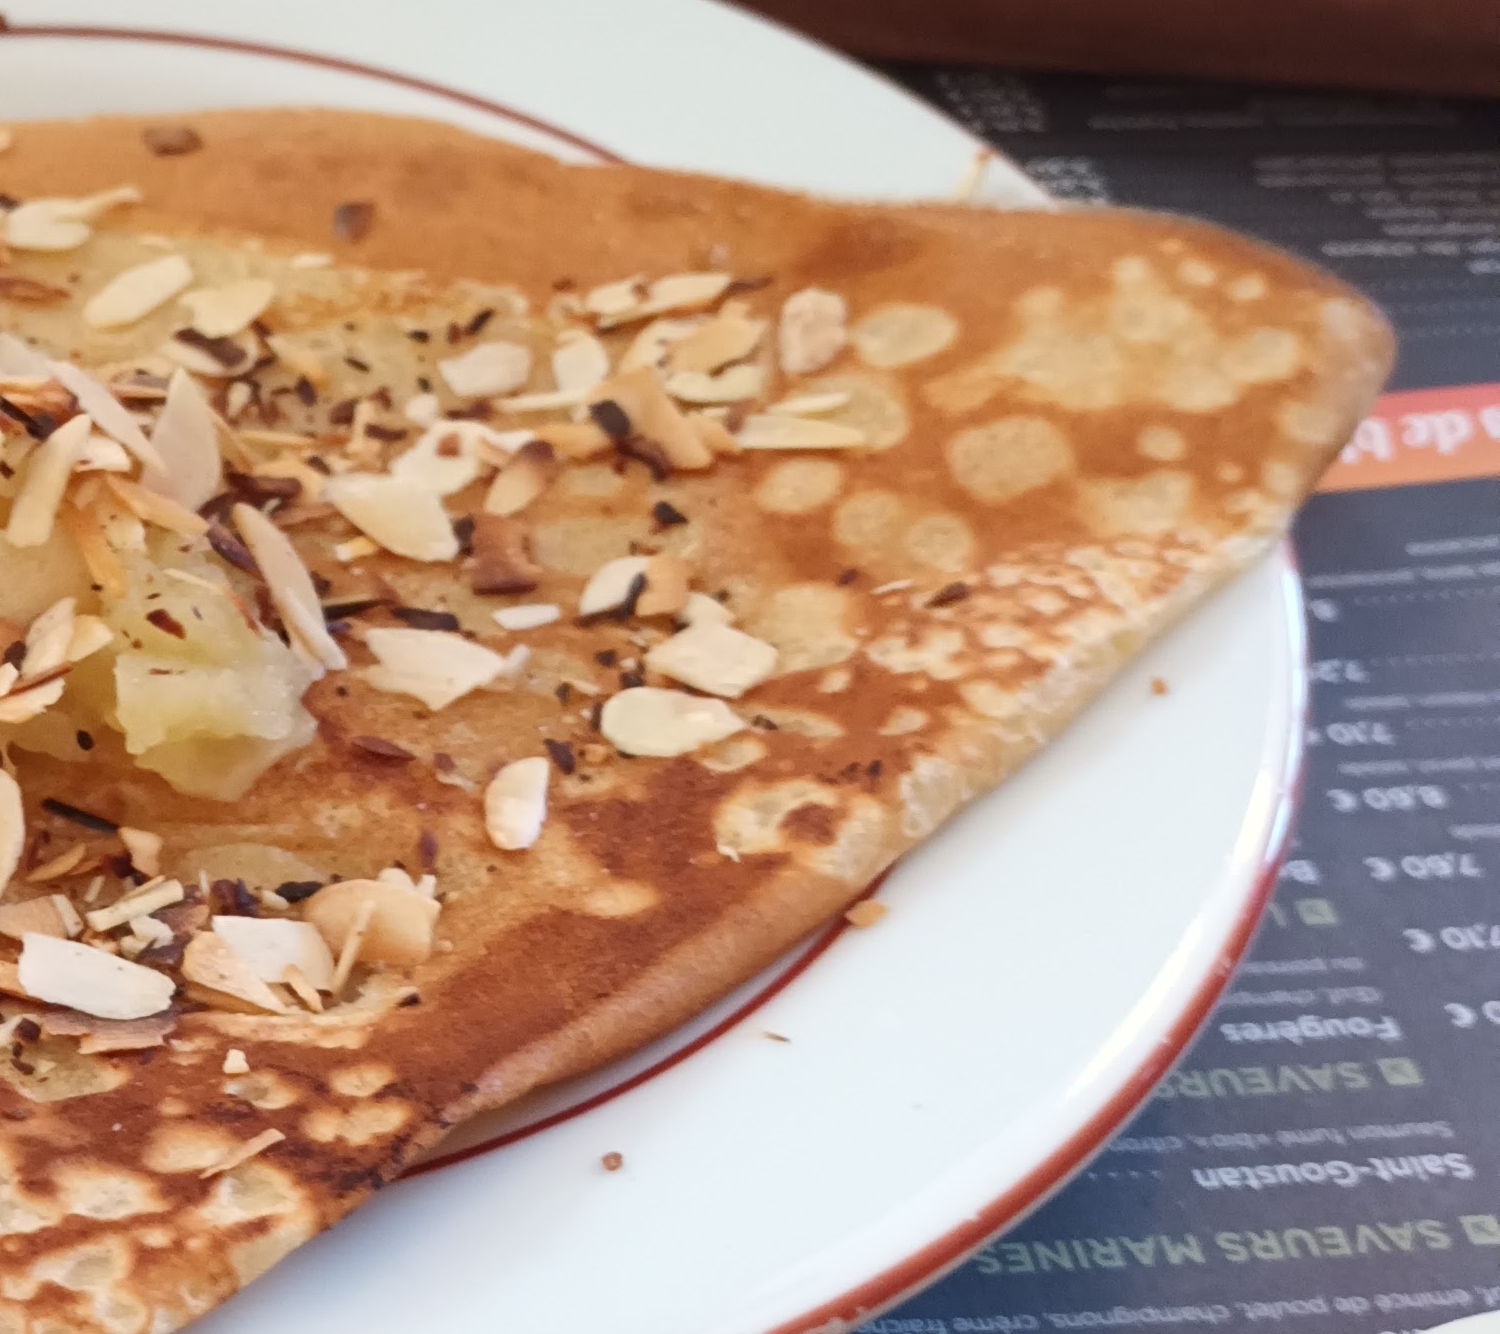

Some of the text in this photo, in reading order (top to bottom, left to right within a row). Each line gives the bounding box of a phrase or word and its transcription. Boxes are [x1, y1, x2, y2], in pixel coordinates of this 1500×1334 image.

[1219, 1014, 1403, 1046] Fougères
[1190, 1152, 1475, 1191] Saint-Goustan
[973, 1217, 1452, 1275] SAVEURS MARINES
